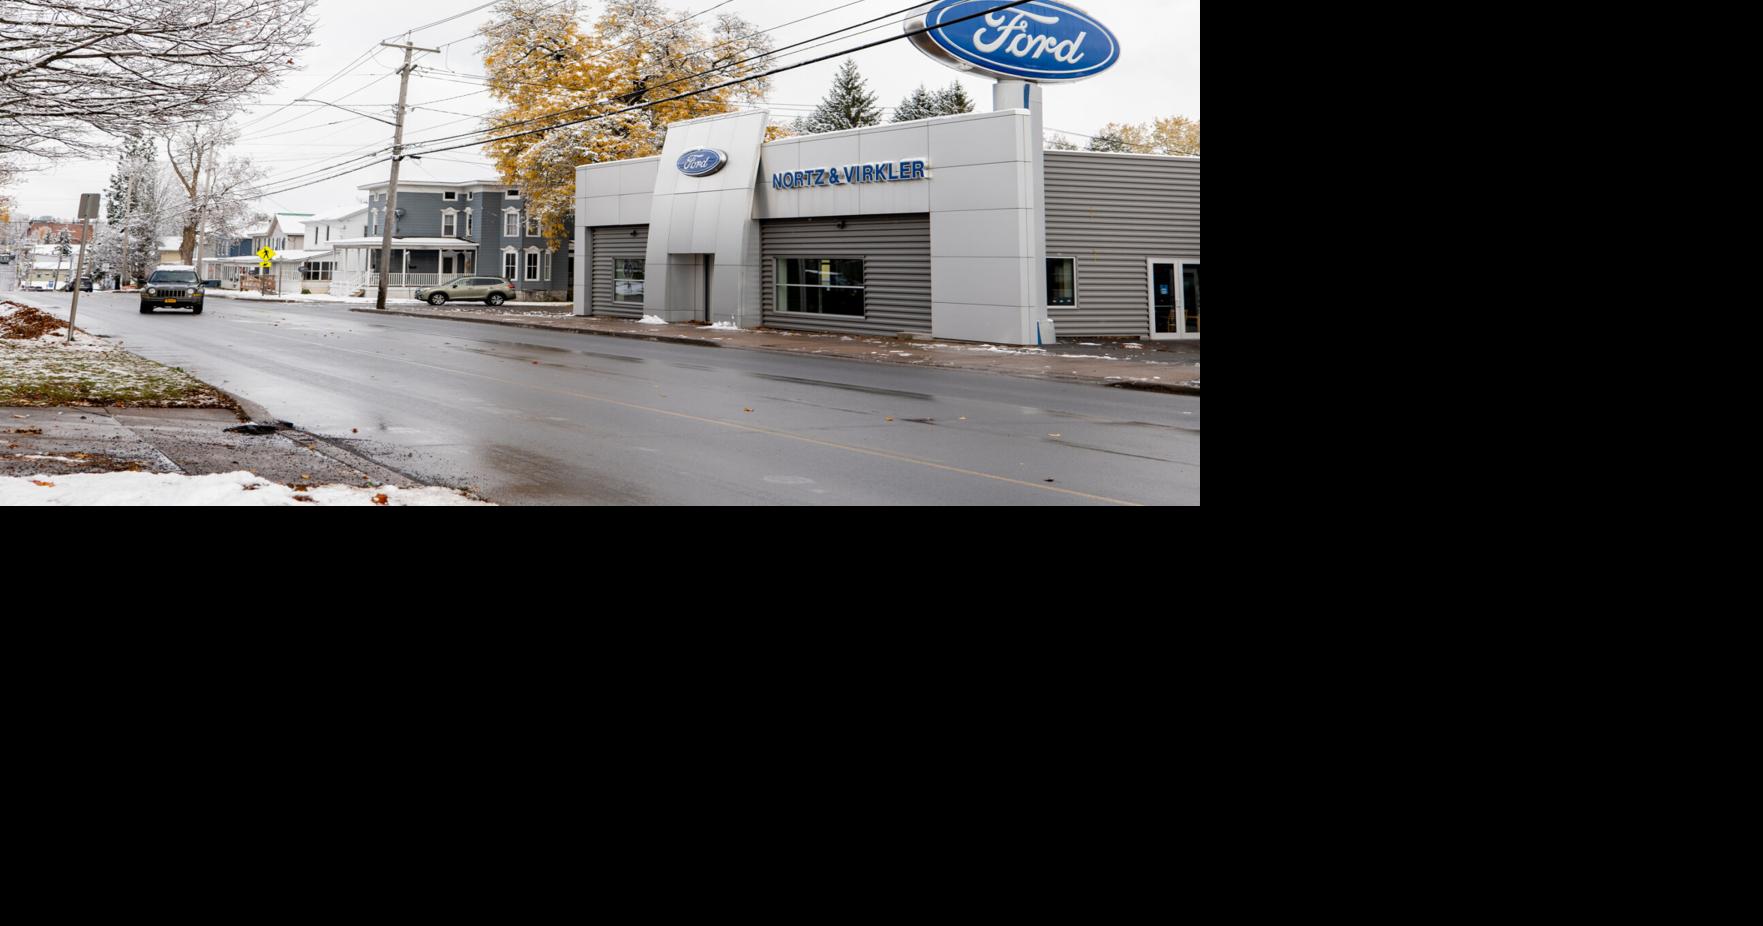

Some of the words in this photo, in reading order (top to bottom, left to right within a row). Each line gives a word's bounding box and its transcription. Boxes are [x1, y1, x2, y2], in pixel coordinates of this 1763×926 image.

[973, 7, 1086, 64] Ford
[683, 154, 710, 170] Ford
[772, 168, 825, 189] NORTZ
[829, 167, 839, 184] &
[843, 160, 925, 183] VIRKLER
